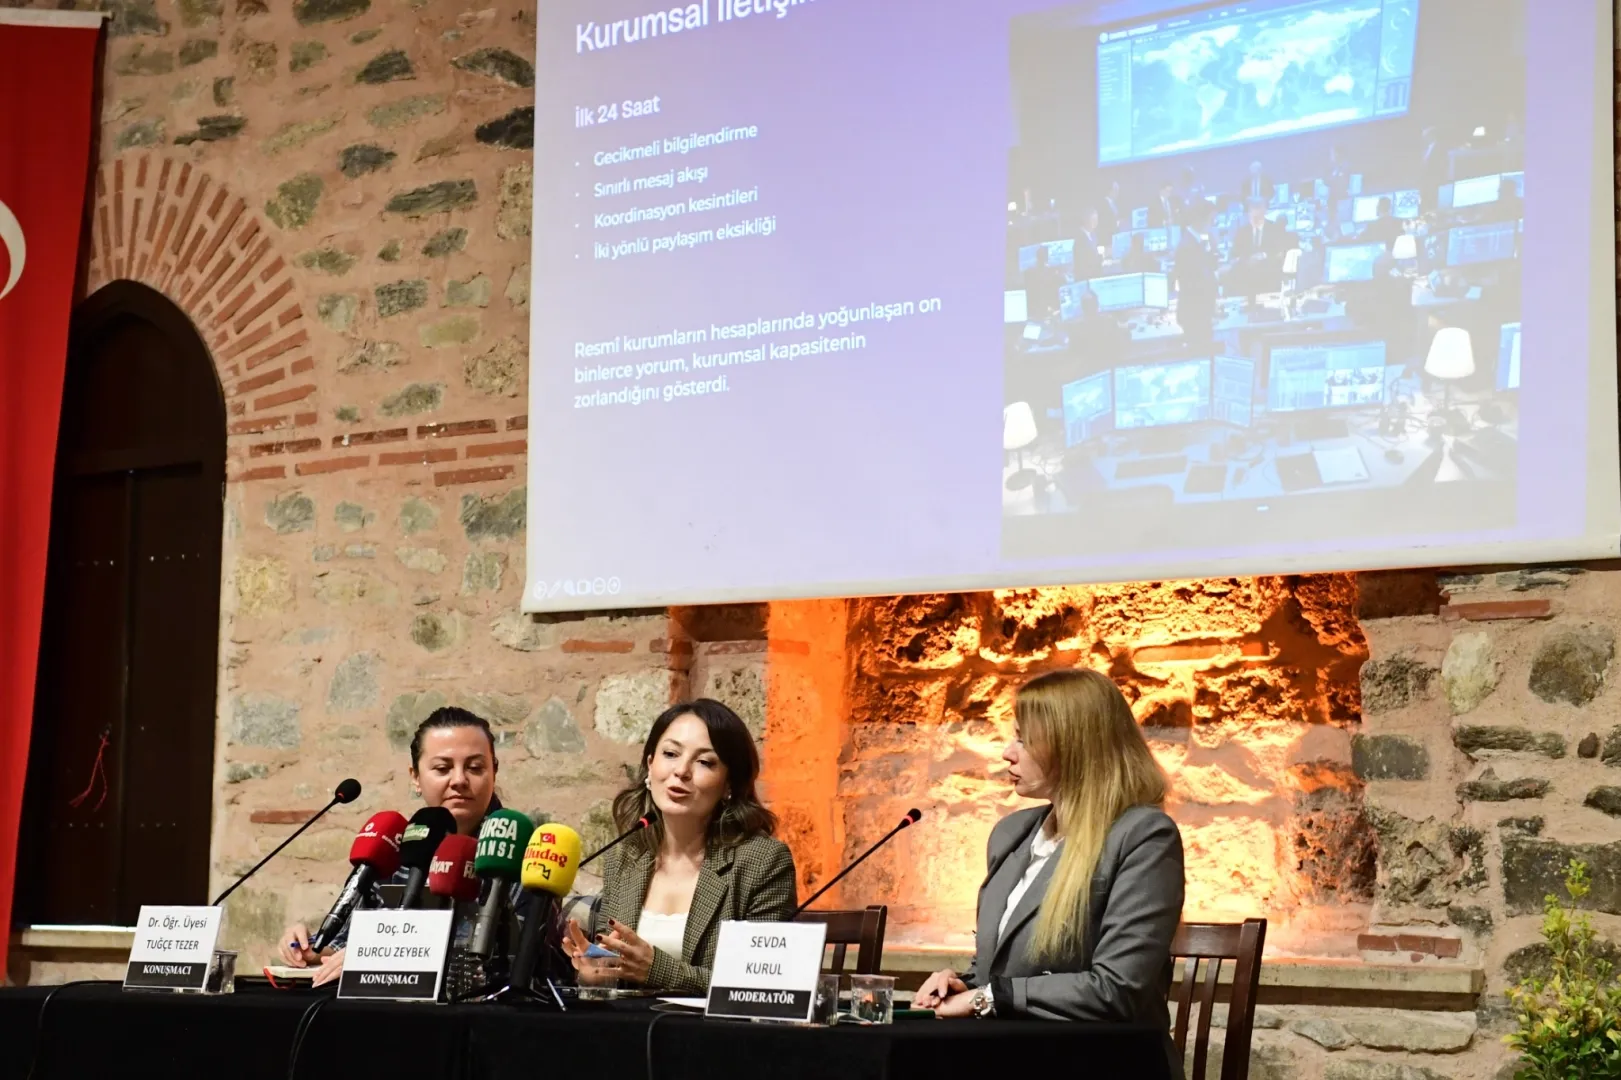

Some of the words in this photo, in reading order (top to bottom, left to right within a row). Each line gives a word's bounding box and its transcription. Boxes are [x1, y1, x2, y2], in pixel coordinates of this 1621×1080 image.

[576, 0, 709, 53] Kurumsal
[575, 105, 594, 129] İlk
[597, 103, 618, 124] 24
[621, 95, 661, 119] Saat
[593, 140, 661, 166] Gecikmeli
[663, 124, 758, 155] bilgilendirme
[593, 177, 631, 198] Sınırlı
[633, 169, 675, 191] mesaj
[677, 165, 708, 183] akışı
[594, 201, 686, 229] Koordinasyon
[688, 186, 758, 213] kesintileri
[593, 241, 610, 260] İki
[611, 236, 650, 261] yönlü
[652, 228, 714, 254] paylaşım
[716, 215, 777, 241] eksikliği
[575, 336, 621, 359] Resmî
[623, 327, 707, 353] kurumların
[710, 314, 815, 342] hesaplarında
[818, 301, 914, 329] yoğunlaşan
[918, 297, 942, 313] on
[574, 362, 633, 384] binlerce
[635, 357, 690, 380] yorum,
[692, 344, 766, 369] kurumsal
[769, 333, 866, 361] kapasitenin
[574, 386, 660, 409] zorlandığını
[662, 374, 731, 400] gösterdi.
[478, 817, 518, 841] URSA
[148, 917, 160, 928] Dr.
[162, 914, 181, 930] Öğr.
[183, 914, 208, 931] Üyesi
[376, 922, 399, 937] Doç.
[402, 922, 418, 934] Dr.
[146, 937, 173, 952] TUĞÇE
[175, 940, 199, 950] TEZER
[357, 946, 391, 958] BURCU
[393, 946, 431, 958] ZEYBEK
[750, 935, 787, 949] SEVDA
[142, 964, 192, 977] KONUŞMACI
[360, 973, 419, 987] KONUŞMACI
[745, 961, 783, 976] KURUL
[728, 989, 795, 1005] MODERATÖR
